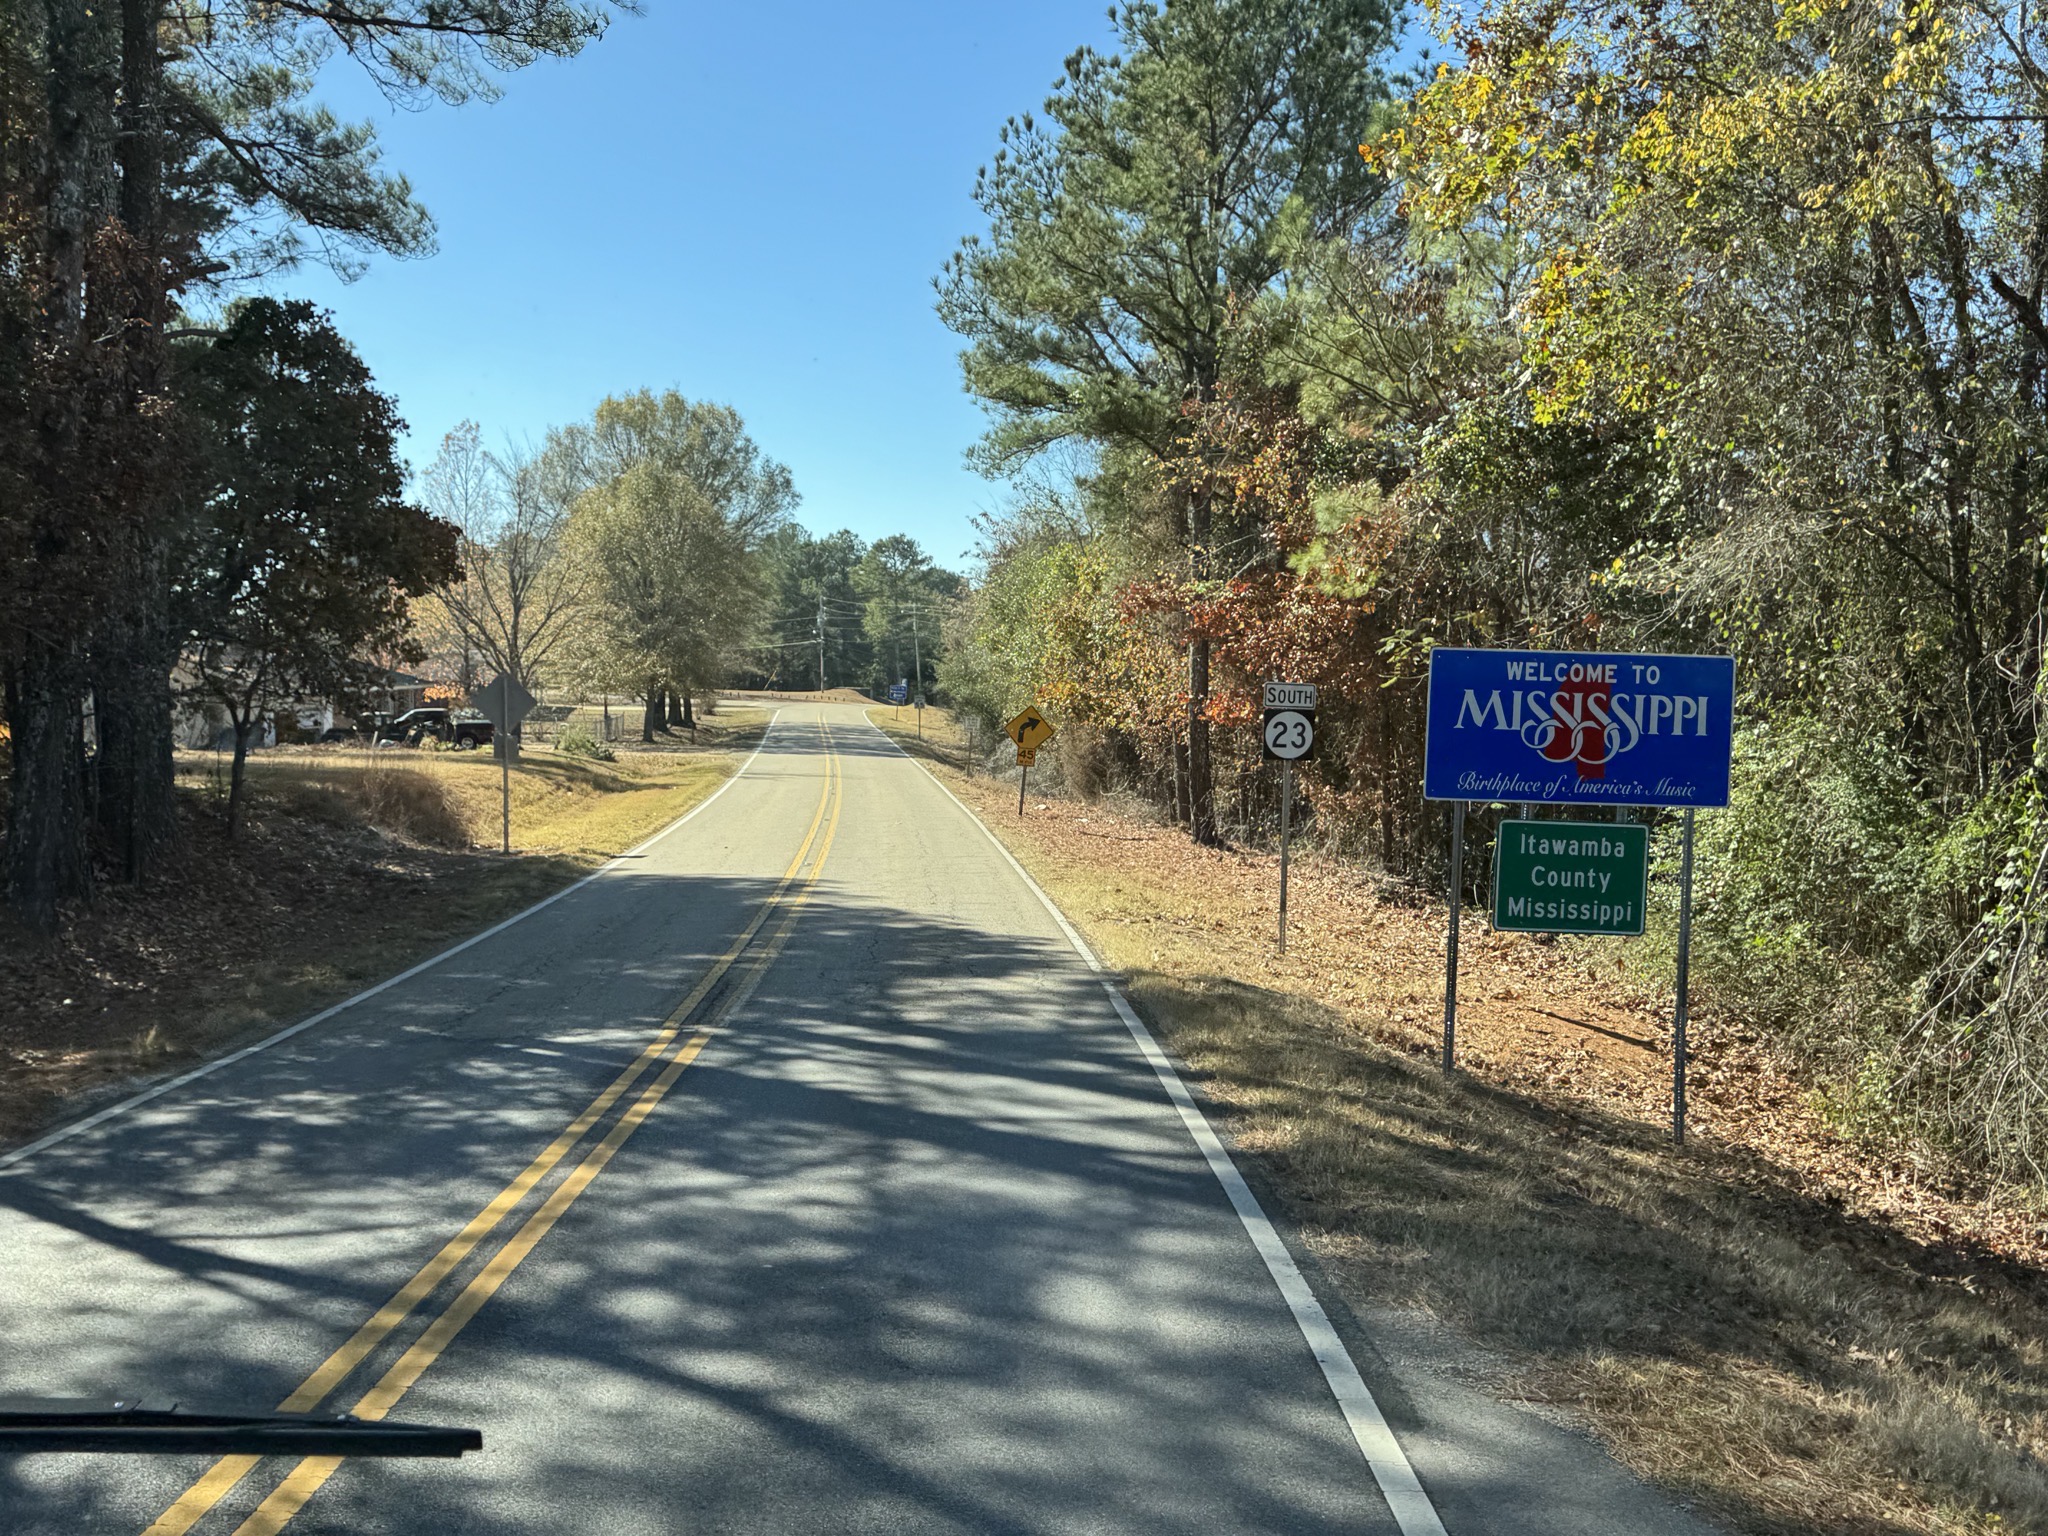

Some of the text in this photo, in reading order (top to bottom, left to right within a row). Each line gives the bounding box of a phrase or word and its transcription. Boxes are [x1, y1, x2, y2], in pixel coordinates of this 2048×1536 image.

[1507, 661, 1661, 685] WELCOME TO
[1267, 687, 1313, 704] SOUTH
[1272, 721, 1306, 748] 23
[1018, 749, 1034, 760] 45
[1457, 771, 1696, 799] Birthplace of America's Music
[1520, 833, 1626, 858] Itawamba
[1531, 865, 1611, 893] County
[1508, 896, 1632, 926] Mississippi
